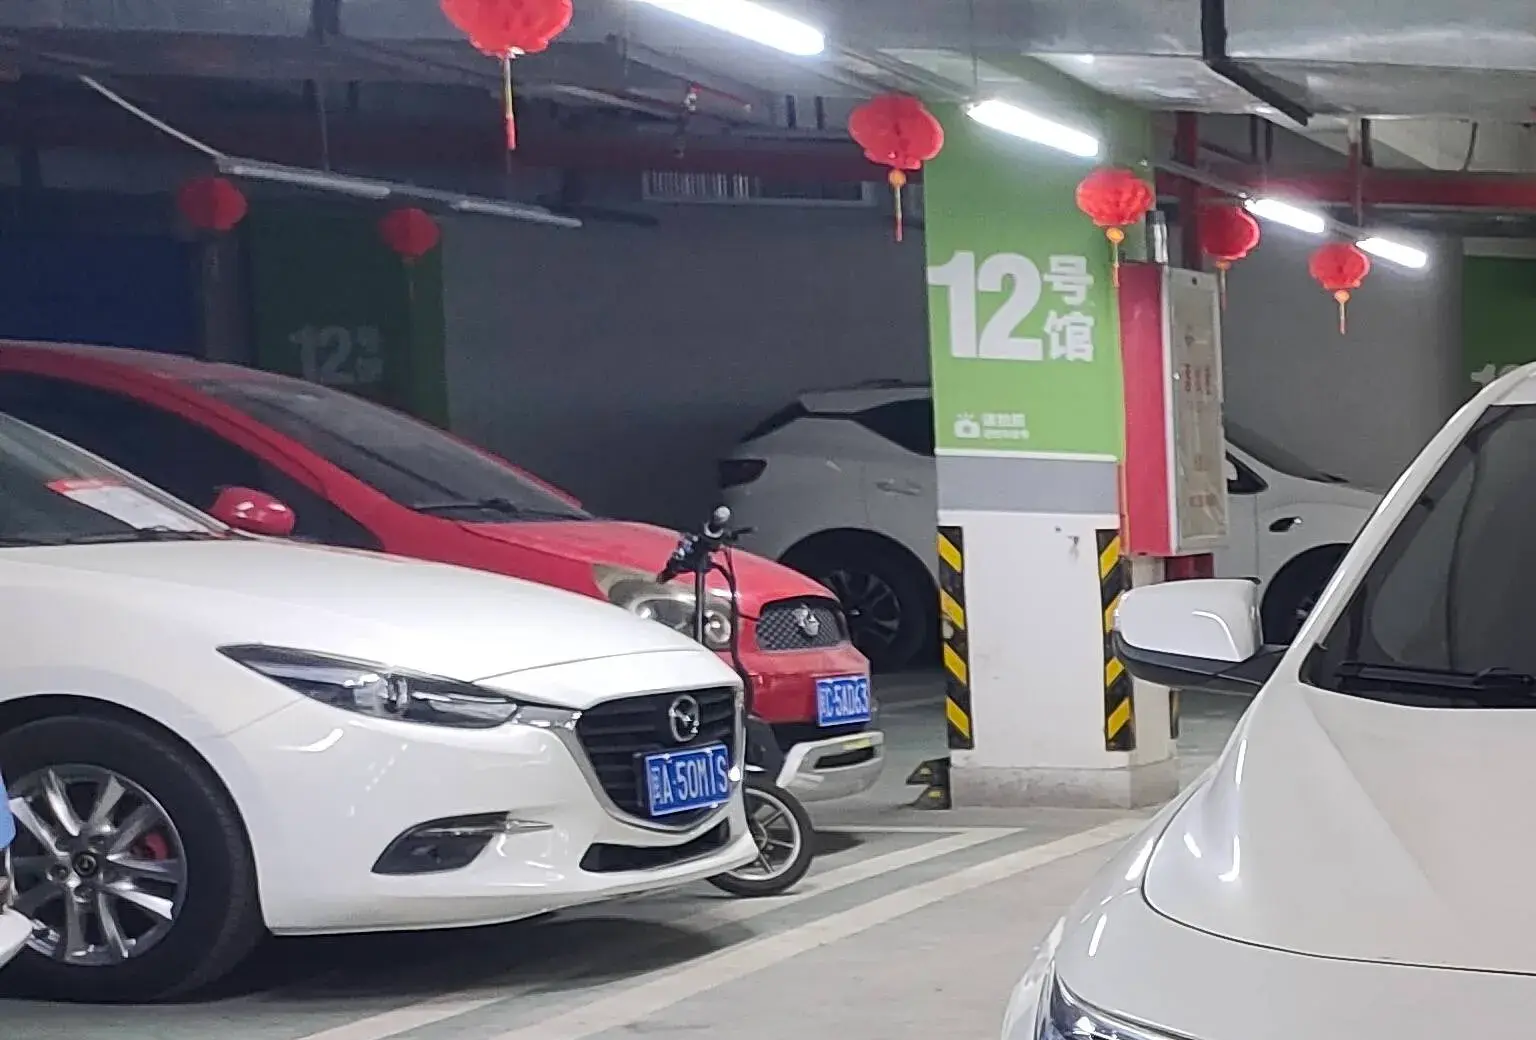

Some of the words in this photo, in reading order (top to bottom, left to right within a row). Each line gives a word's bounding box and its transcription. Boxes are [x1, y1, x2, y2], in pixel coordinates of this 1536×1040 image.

[927, 251, 1044, 361] 12
[1044, 255, 1094, 362] 号馆
[288, 324, 355, 384] 12
